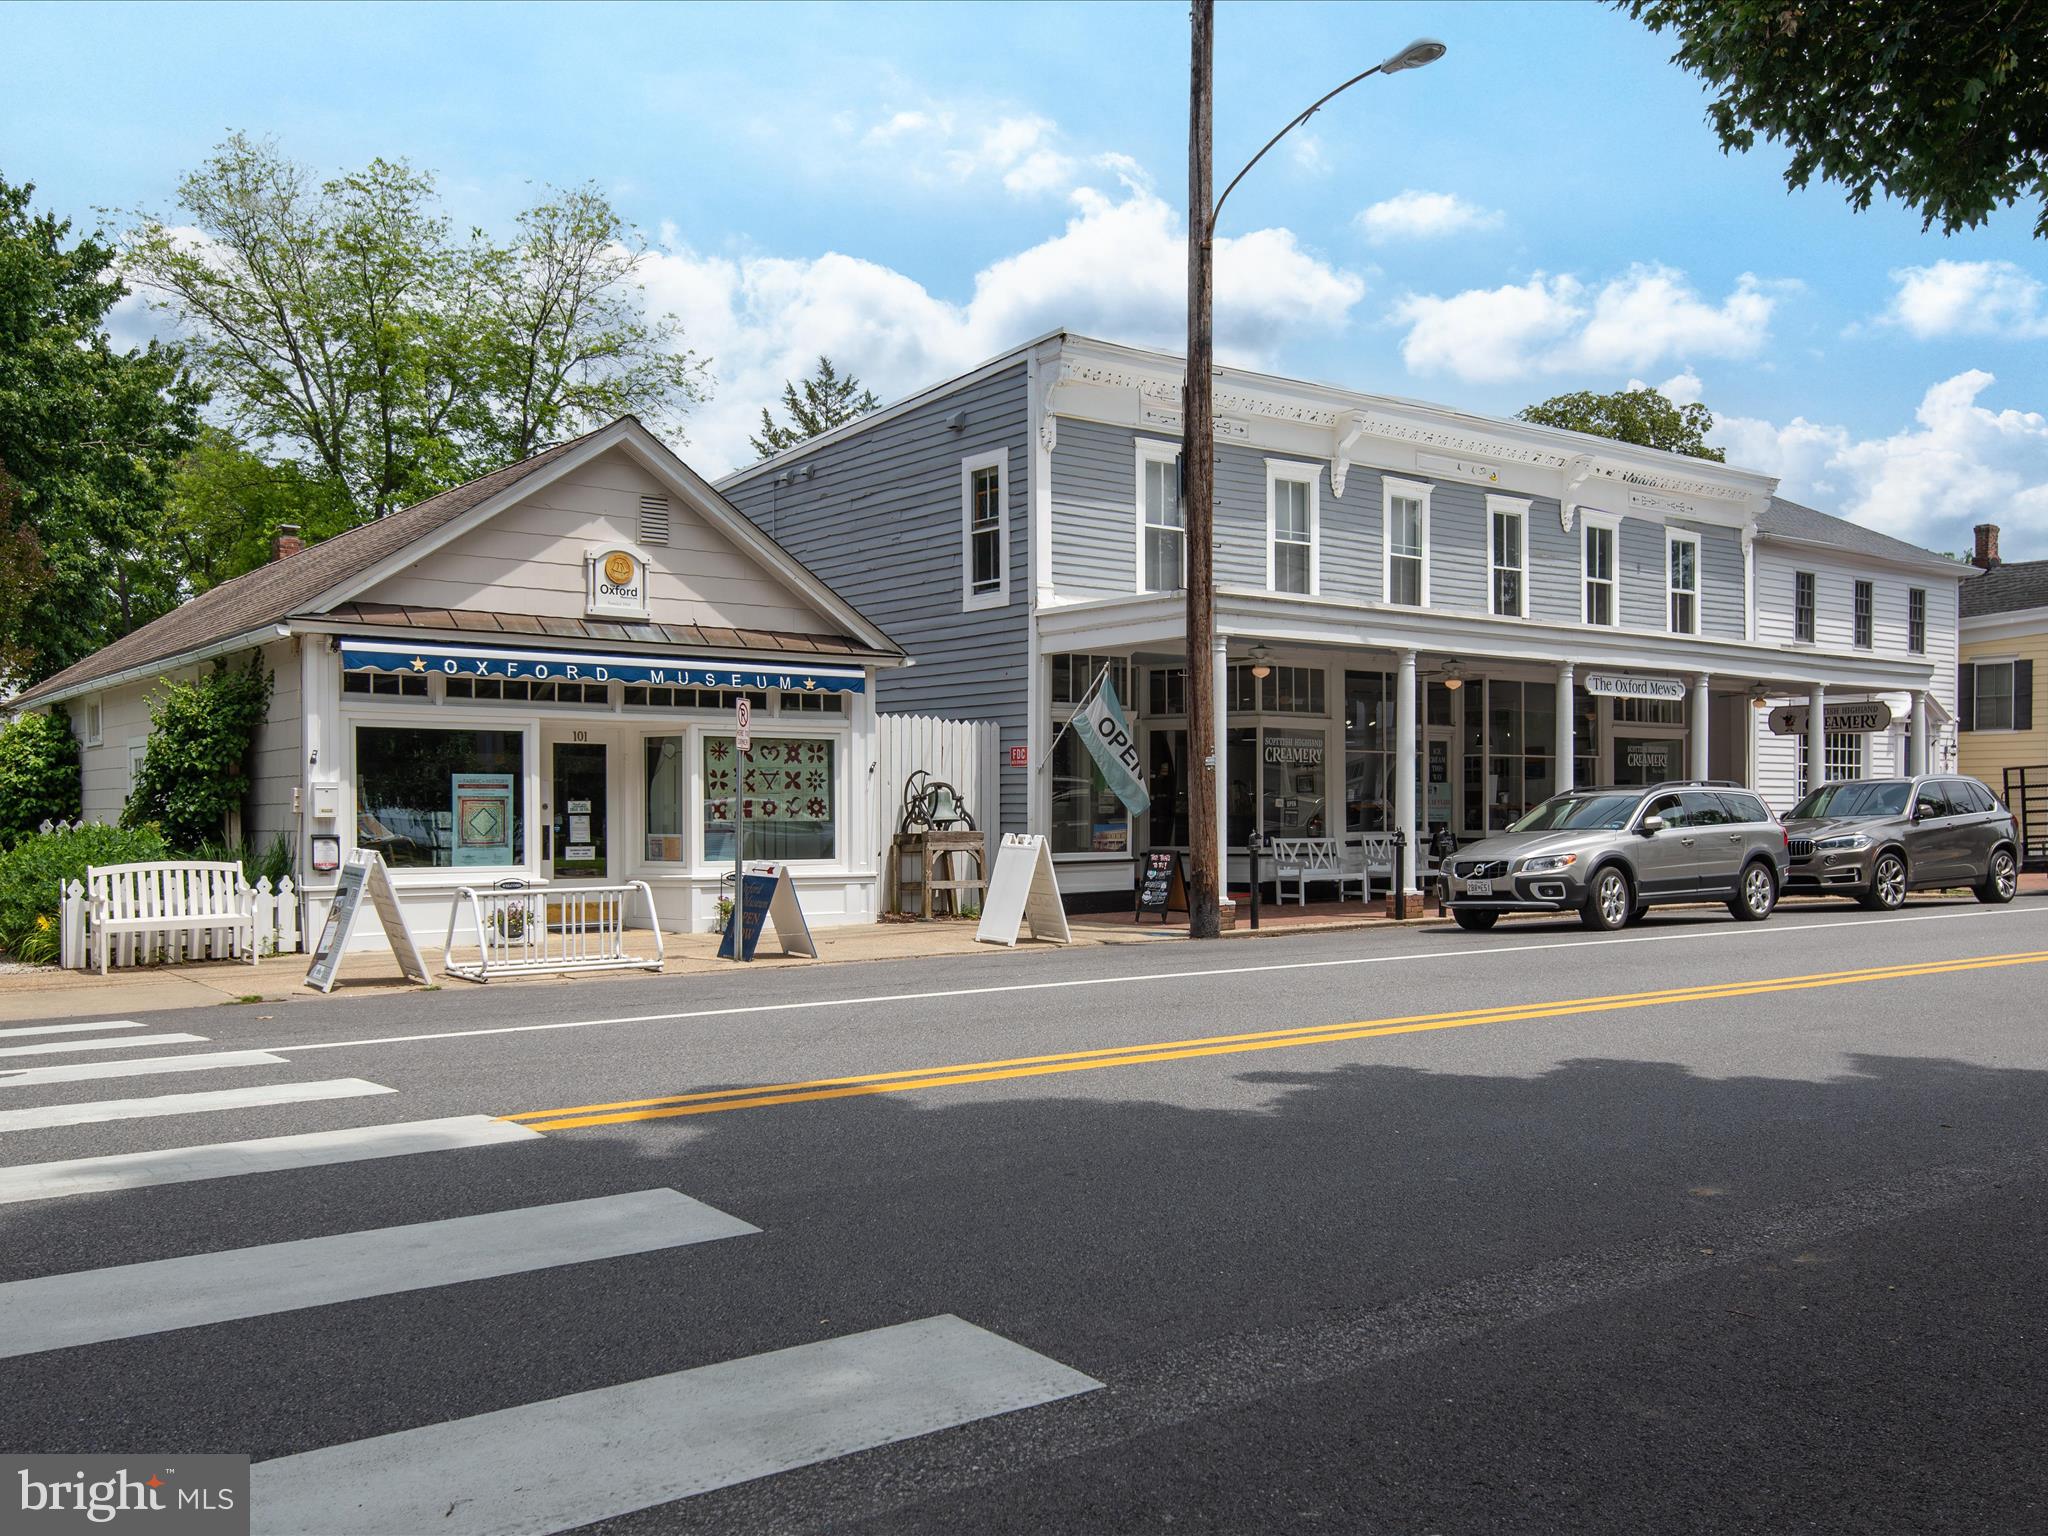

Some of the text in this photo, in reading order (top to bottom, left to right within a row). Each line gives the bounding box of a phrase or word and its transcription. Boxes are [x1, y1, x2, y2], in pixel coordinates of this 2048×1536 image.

[600, 584, 638, 597] Oxford
[443, 659, 791, 690] OXFORD MUSEUM
[1592, 677, 1677, 696] The Oxford Mews
[1841, 705, 1878, 715] HIGHLAND
[572, 731, 588, 742] 101
[1264, 736, 1293, 746] SCOTTISH
[1098, 717, 1144, 781] OPEN
[1264, 746, 1323, 764] CREAMERY
[1627, 753, 1669, 767] CREAMERY
